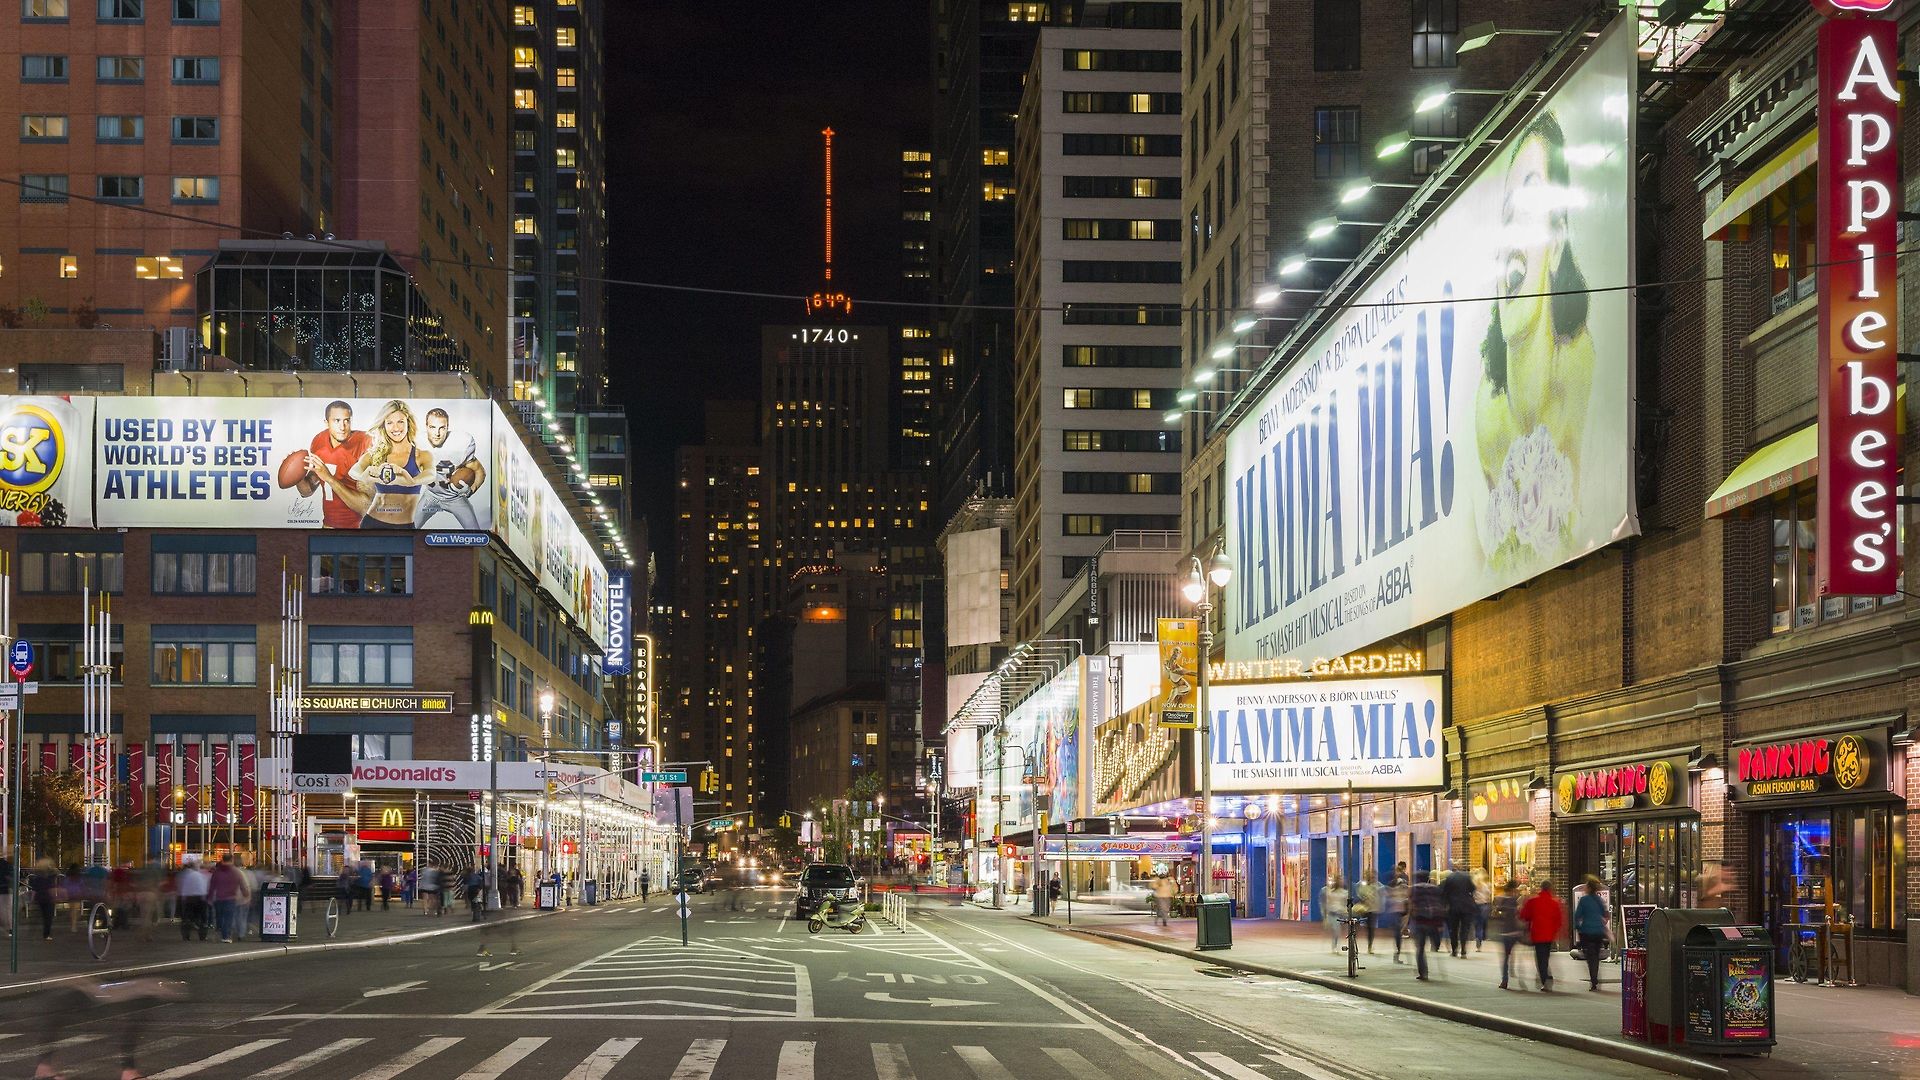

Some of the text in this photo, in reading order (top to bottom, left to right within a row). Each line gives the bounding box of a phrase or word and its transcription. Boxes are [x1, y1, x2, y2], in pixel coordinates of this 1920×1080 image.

[1838, 35, 1900, 573] Applebee's
[1281, 361, 1323, 418] ANDERSSON
[1325, 350, 1332, 370] &
[104, 418, 273, 442] USED BY THE
[104, 445, 272, 466] WORLD'S BEST
[1235, 280, 1455, 636] MAMMA MIA!
[103, 469, 271, 500] ATHLETES
[0, 489, 51, 513] NERGY
[429, 535, 486, 546] Van Wagner
[1376, 561, 1412, 610] ABBA
[608, 577, 624, 661] NOVOTEL
[1256, 595, 1344, 660] THE SMASH HIT MUSICAL
[1208, 652, 1422, 681] WINTER GARDEN
[276, 697, 447, 709] TES SQUARE CHURCH annex
[637, 648, 647, 736] BROADWAY
[1237, 694, 1264, 706] BENNY
[1265, 693, 1317, 704] ANDERSSON
[1319, 693, 1326, 702] &
[1329, 690, 1358, 702] BJÖRN
[471, 714, 479, 762] onald's
[483, 714, 492, 762] onald's
[1209, 705, 1341, 764] MAMMA
[1350, 699, 1436, 761] MIA!
[352, 766, 456, 782] McDonald's
[1232, 766, 1340, 779] THE SMASH HIT MUSICAL
[1371, 764, 1402, 775] ABBA
[1738, 739, 1830, 783] NANKING
[294, 774, 330, 787] Così
[1752, 779, 1815, 795] ASIAN FUSION BAR
[1100, 842, 1145, 852] STARDUST
